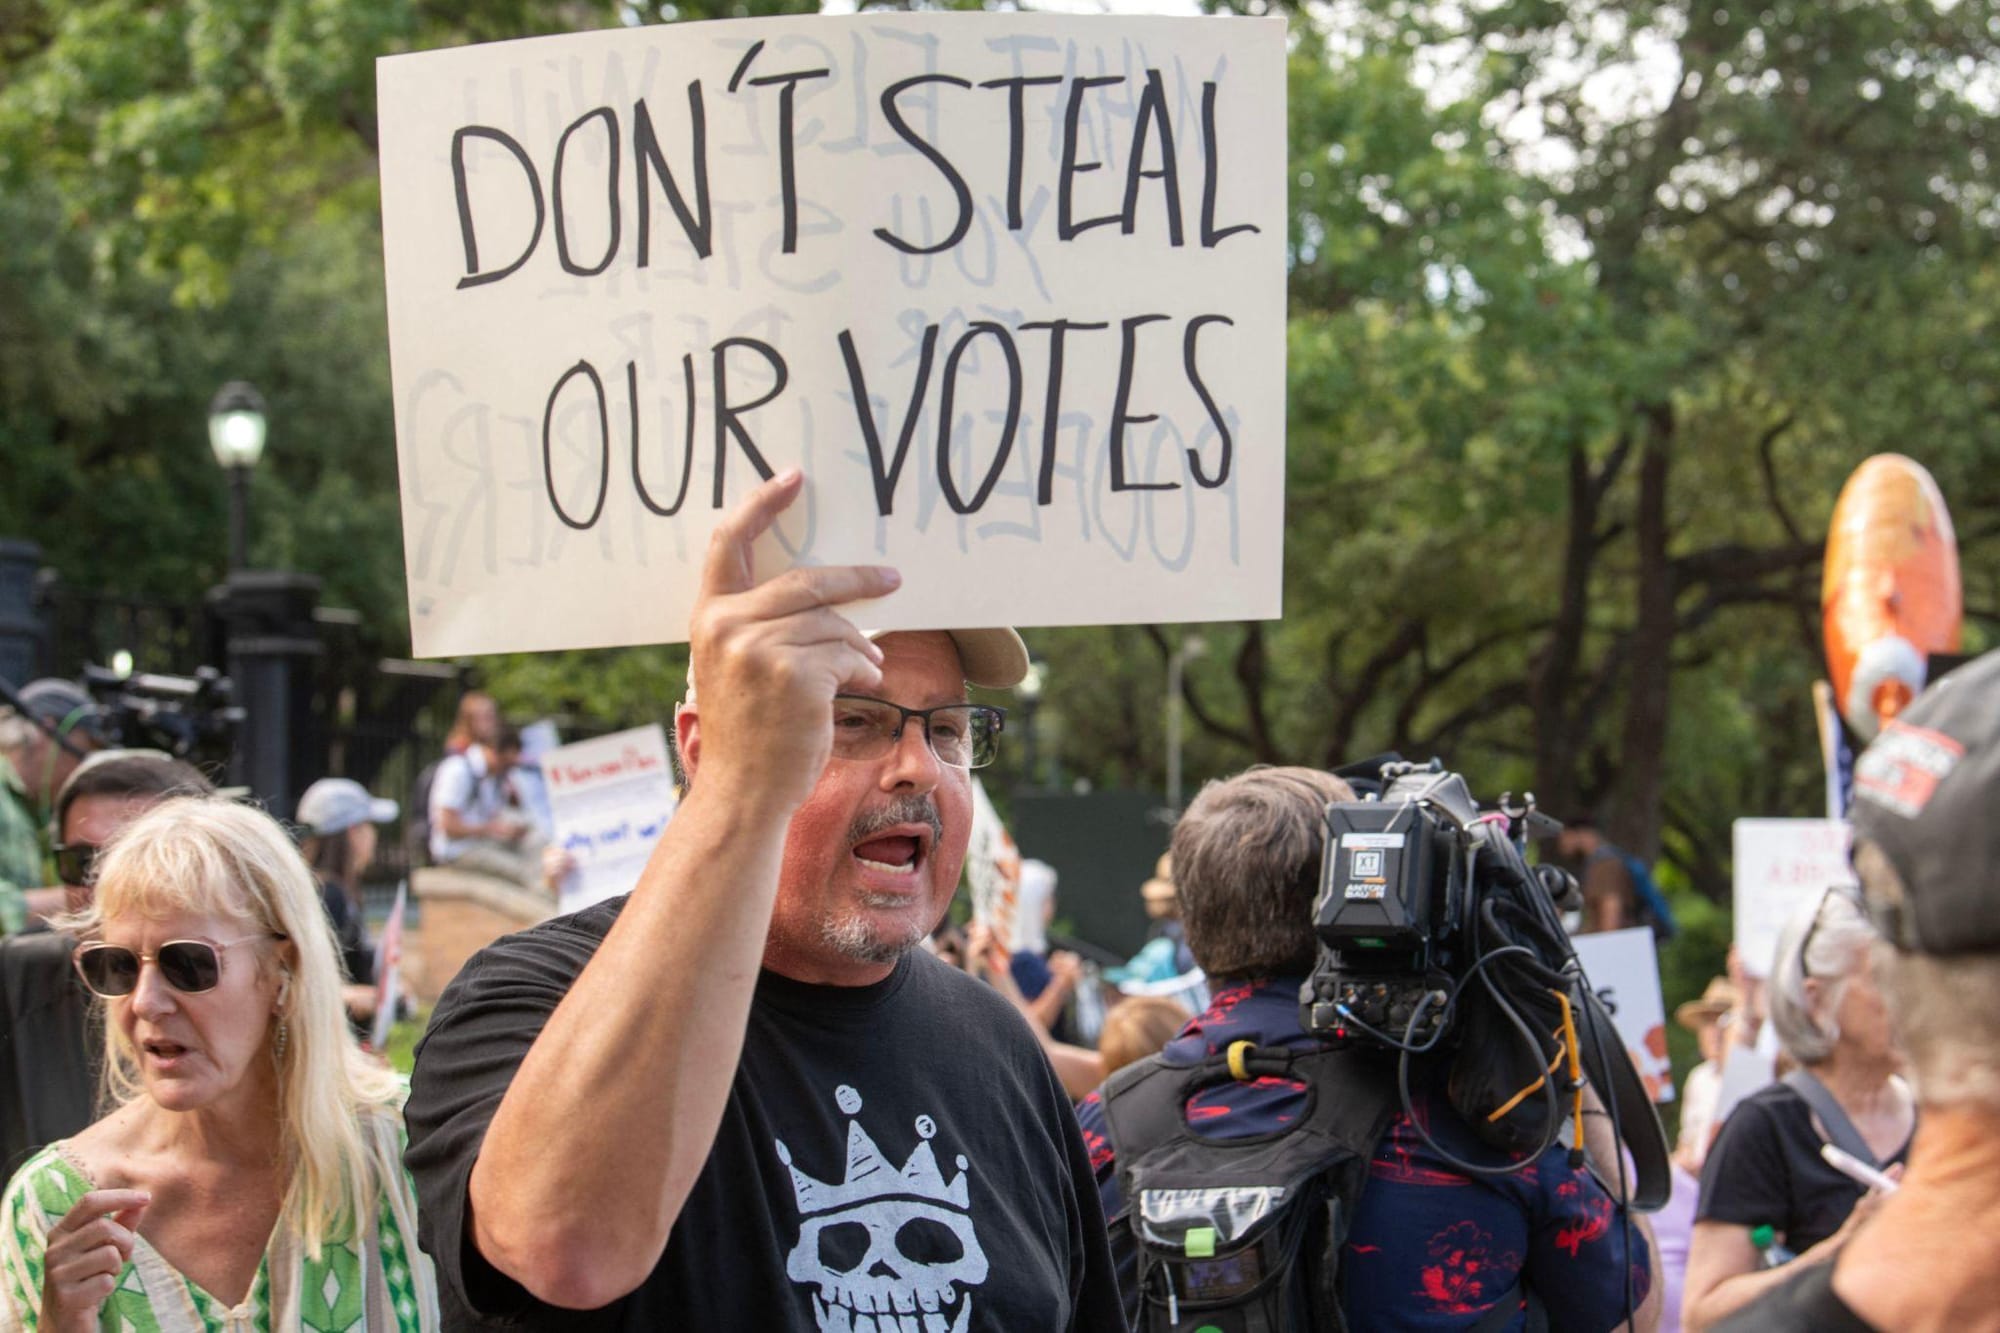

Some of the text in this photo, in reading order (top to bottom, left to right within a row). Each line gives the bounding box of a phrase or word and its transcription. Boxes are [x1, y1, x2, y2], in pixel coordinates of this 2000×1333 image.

[451, 40, 1261, 290] DON'T STEAL
[543, 314, 1234, 530] OUR VOTES
